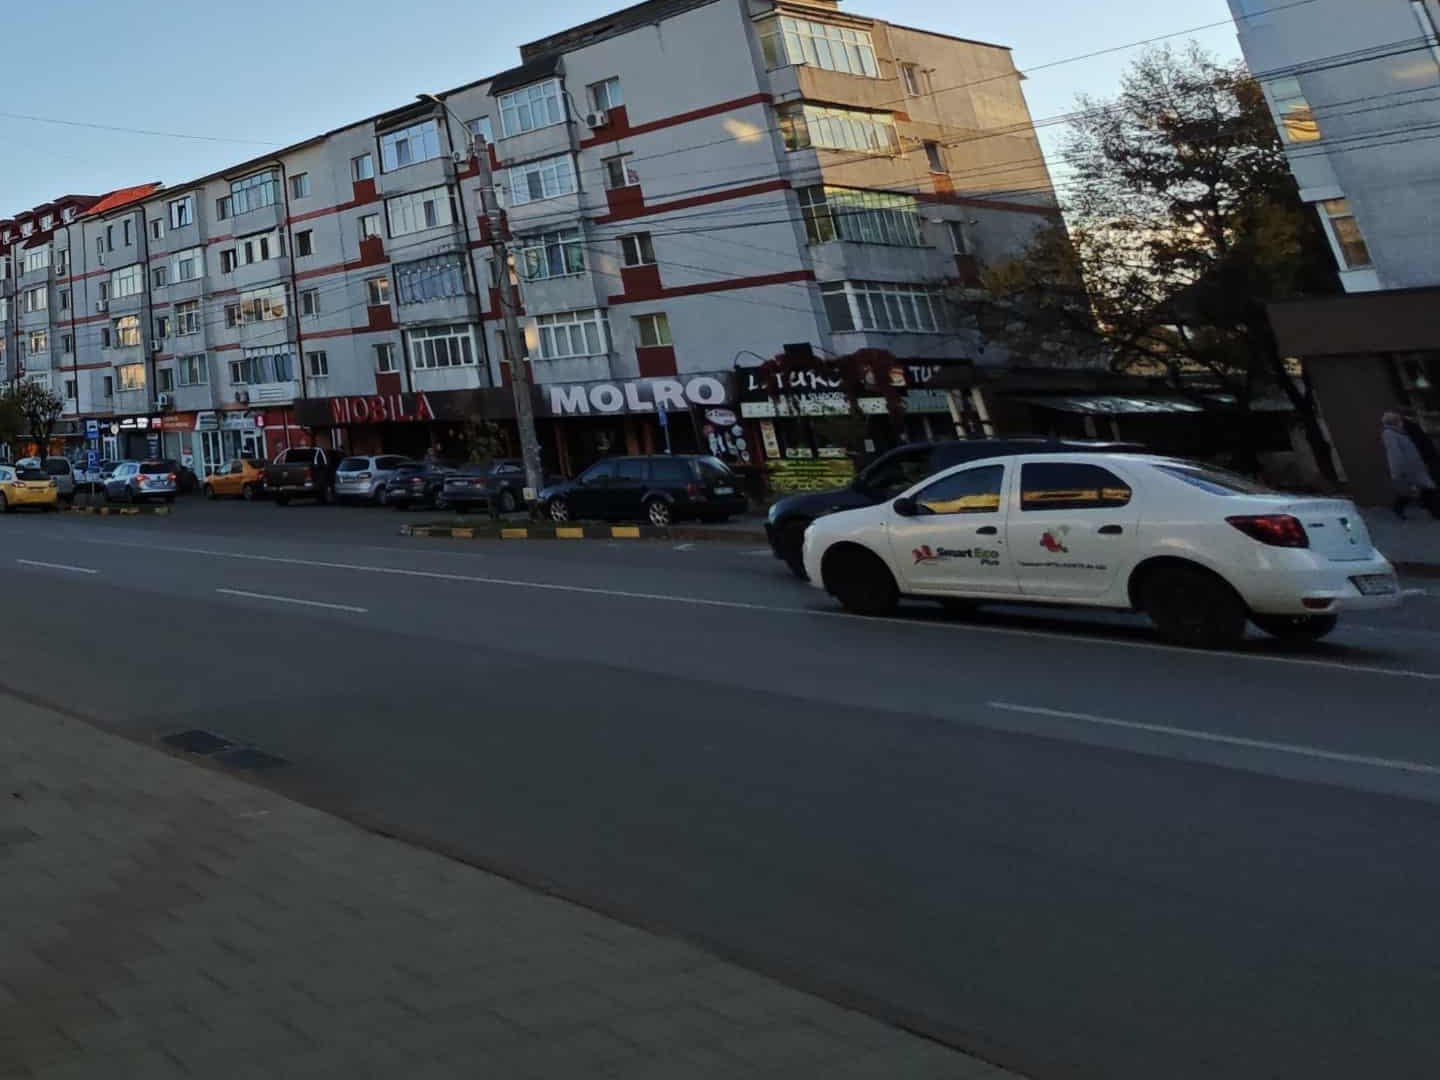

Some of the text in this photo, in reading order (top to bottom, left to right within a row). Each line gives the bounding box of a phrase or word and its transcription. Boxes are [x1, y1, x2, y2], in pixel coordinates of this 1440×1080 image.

[550, 376, 726, 414] MOLRO
[936, 546, 999, 559] Smart Eco
